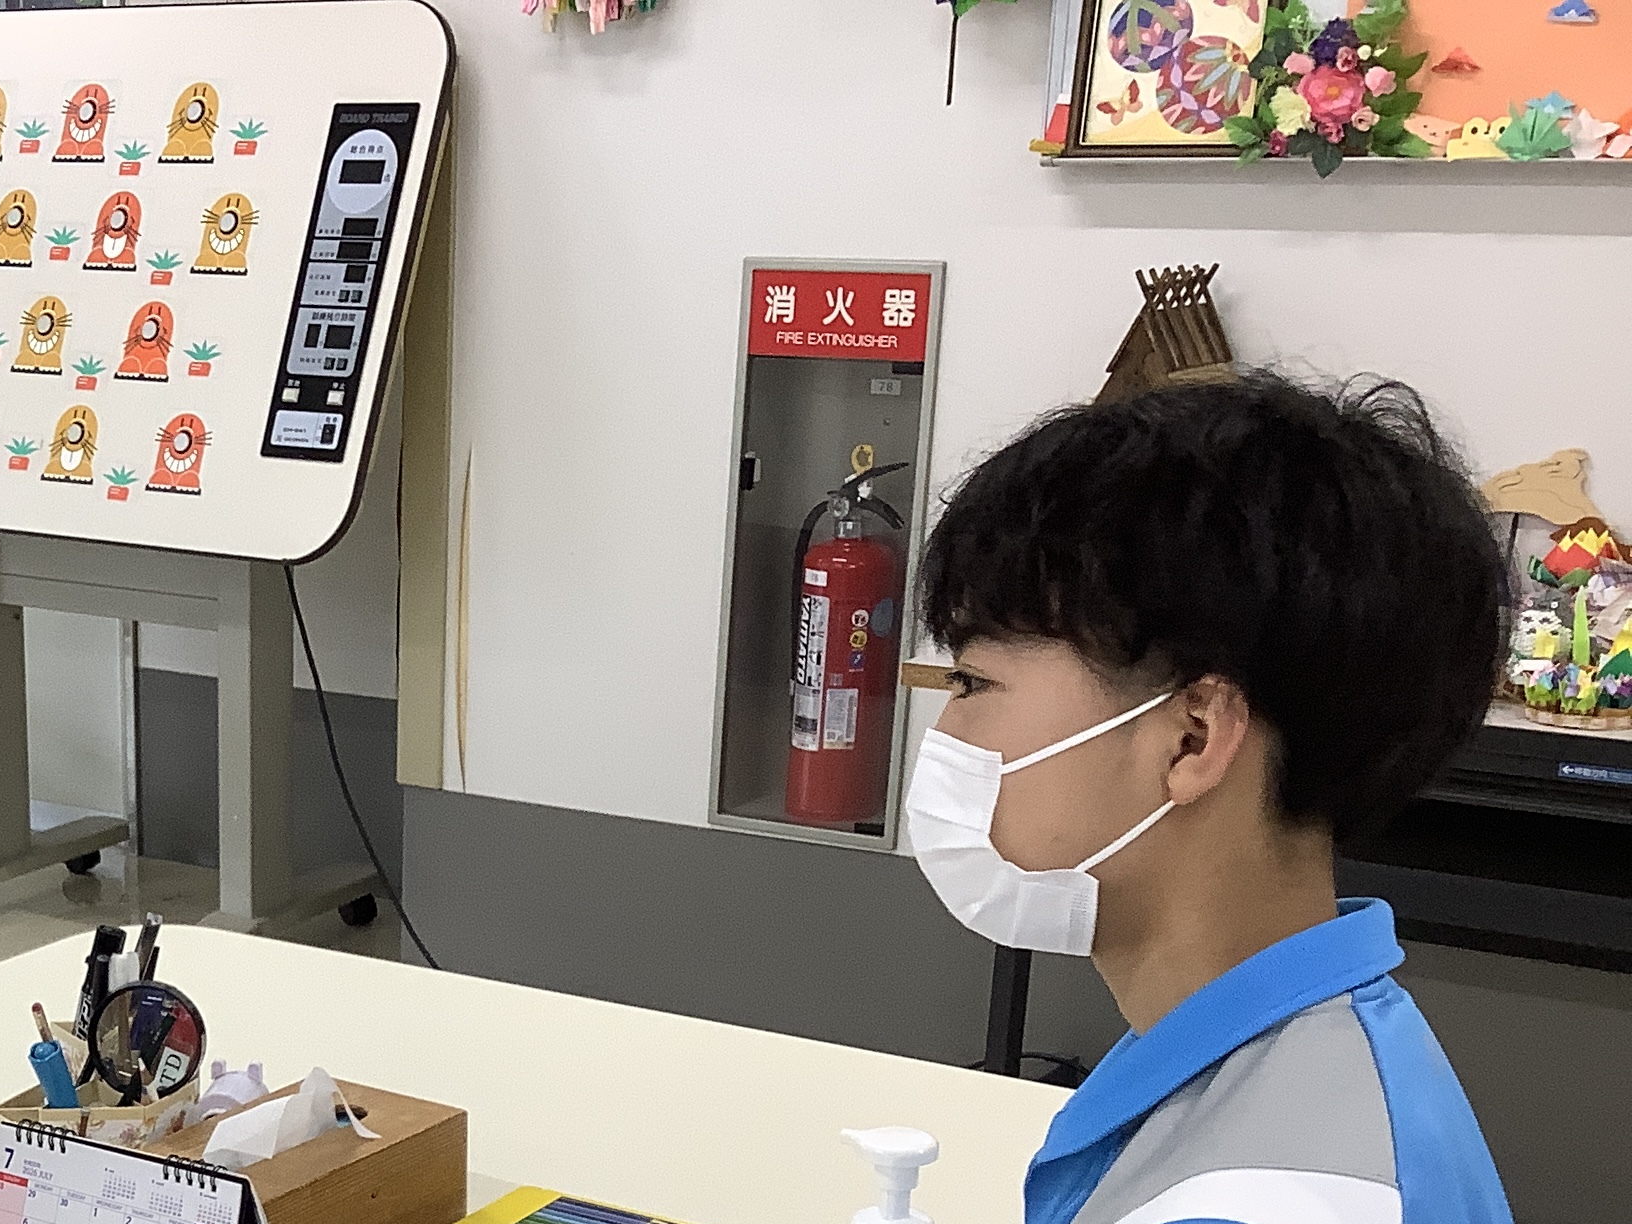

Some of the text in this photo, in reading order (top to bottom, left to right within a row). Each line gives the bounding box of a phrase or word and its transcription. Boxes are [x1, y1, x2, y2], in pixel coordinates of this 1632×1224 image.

[764, 285, 916, 327] 消火器
[776, 331, 898, 348] FIRE EXTINGUISHER
[878, 381, 894, 392] 78
[4, 1147, 14, 1169] 7
[28, 1189, 37, 1198] 29
[60, 1198, 69, 1207] 30
